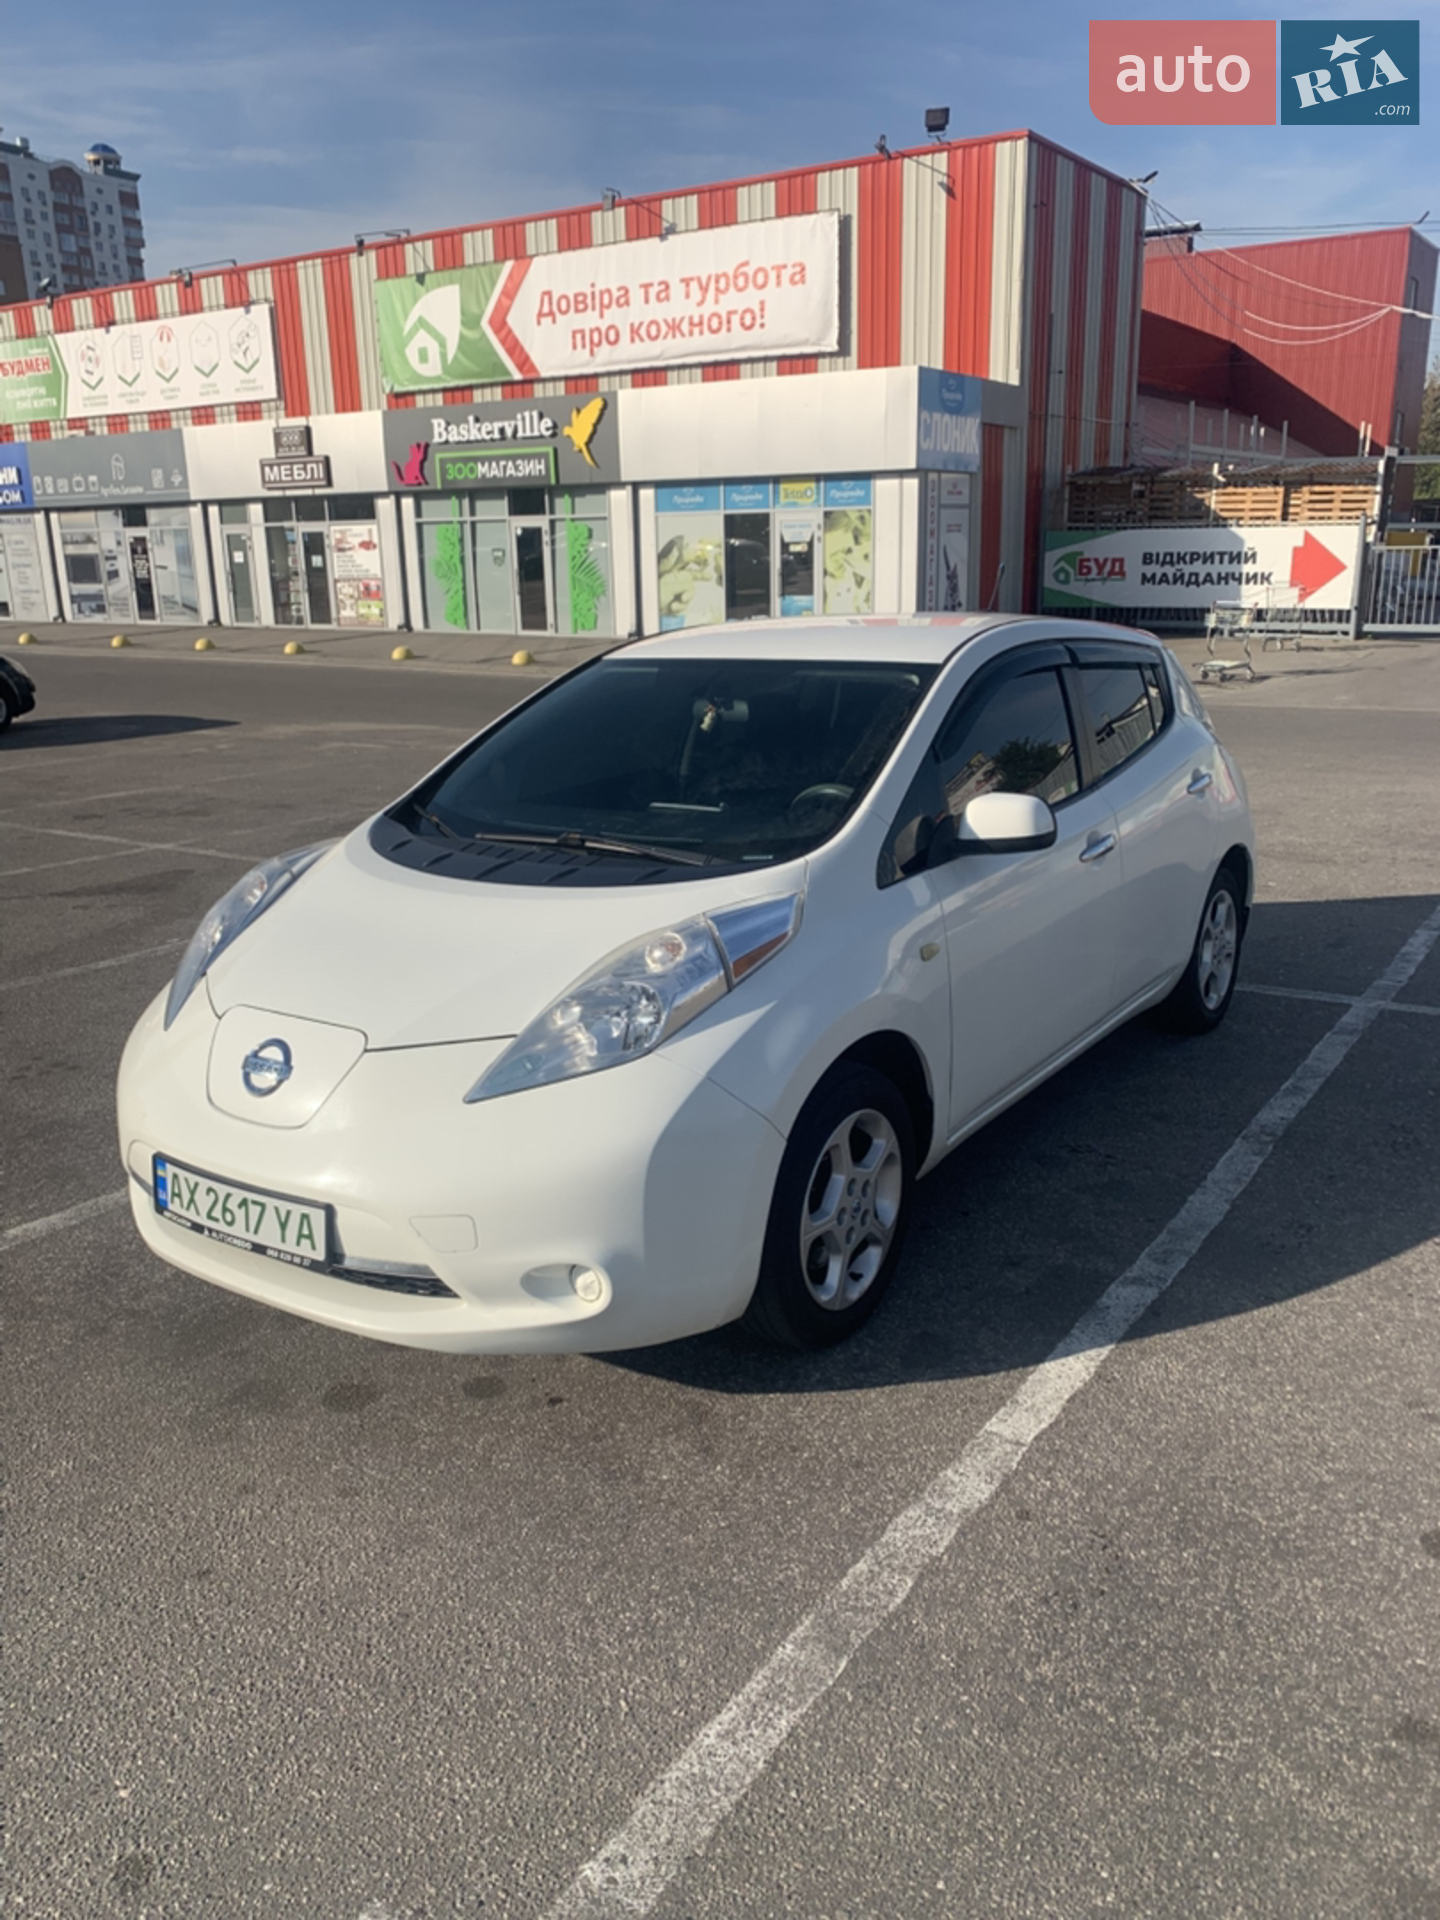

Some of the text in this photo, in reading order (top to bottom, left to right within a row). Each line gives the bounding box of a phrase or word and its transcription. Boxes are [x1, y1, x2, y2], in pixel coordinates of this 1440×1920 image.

[536, 260, 807, 326] Довіра та турбота
[571, 300, 766, 357] про кожного!
[431, 410, 553, 443] Baskerville
[919, 410, 980, 455] СЛОНИК
[263, 462, 324, 482] МЕБЛІ
[445, 458, 546, 480] ЗООМАГАЗИН
[1077, 557, 1127, 579] БУД
[1141, 547, 1257, 567] ВІДКРИТИЙ
[1140, 568, 1273, 587] МАЙДАНЧИК
[170, 1172, 316, 1251] AX 2617 YA
